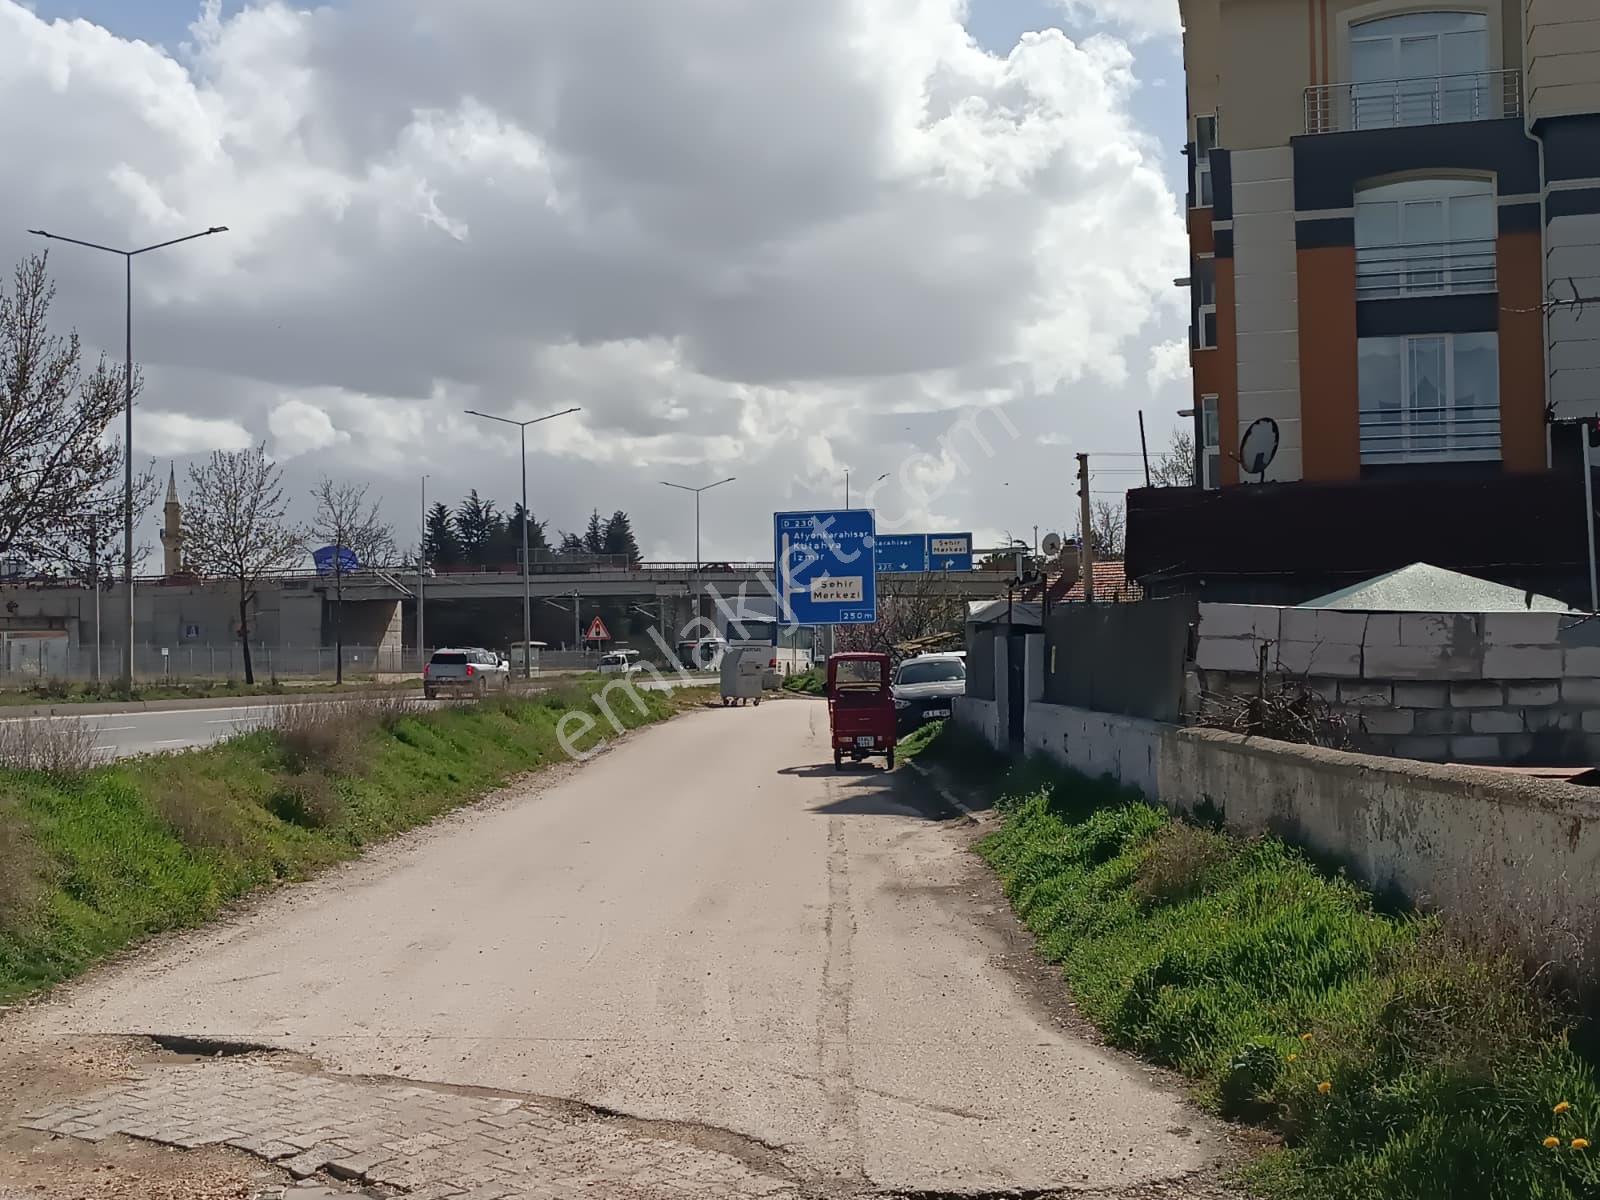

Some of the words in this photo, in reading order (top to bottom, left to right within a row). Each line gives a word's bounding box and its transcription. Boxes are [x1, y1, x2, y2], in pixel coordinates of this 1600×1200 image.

[795, 519, 814, 527] 230
[793, 530, 869, 541] Afyonkarahisar
[813, 590, 860, 600] Merkezi
